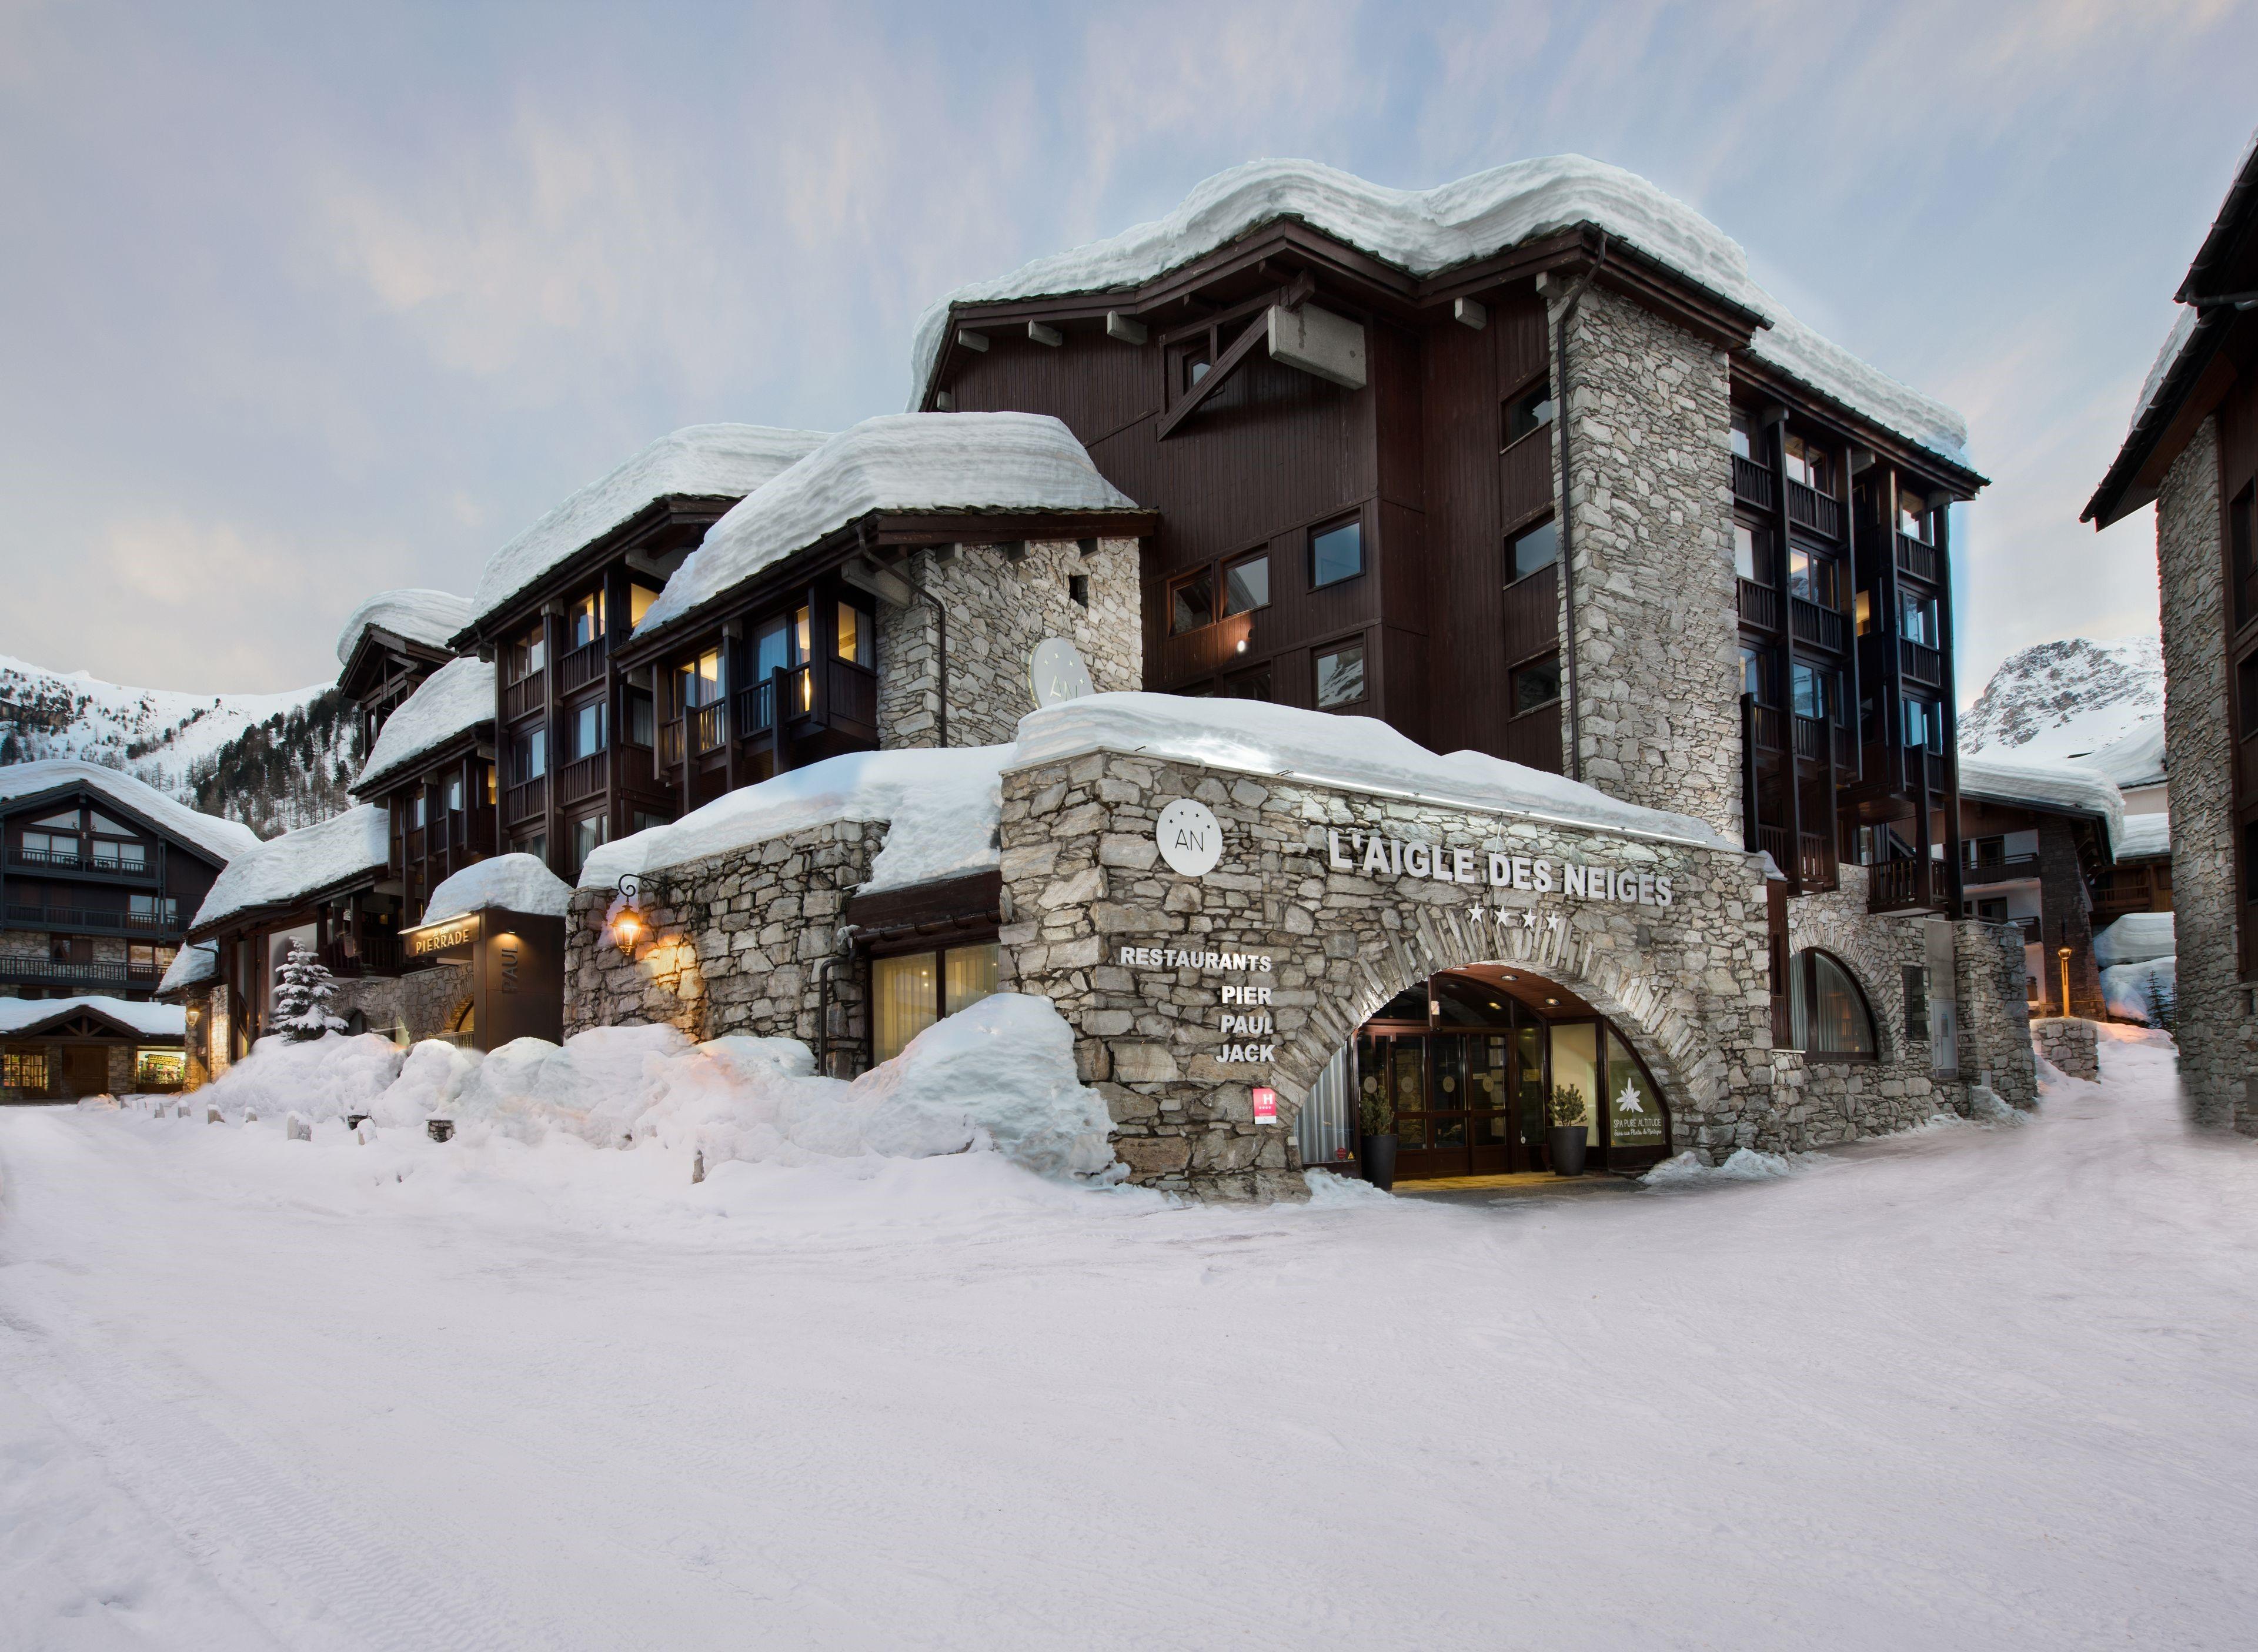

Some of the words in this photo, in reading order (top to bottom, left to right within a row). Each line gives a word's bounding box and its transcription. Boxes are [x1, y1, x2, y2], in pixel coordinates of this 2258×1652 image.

[1175, 828, 1204, 852] AN
[1328, 830, 1475, 884] L'AIGLE
[1489, 852, 1552, 893] DES
[1564, 862, 1673, 907] NEIGES
[416, 928, 470, 954] PIERRADE
[501, 942, 518, 992] PAUL
[1120, 947, 1272, 972] RESTAURANTS
[1221, 985, 1272, 1005] PIER
[1221, 1015, 1274, 1034] PAUL
[1215, 1044, 1276, 1062] JACK
[1263, 1094, 1273, 1105] H
[1613, 1119, 1624, 1128] SPA
[1624, 1119, 1637, 1128] PURE
[1638, 1118, 1662, 1127] ALTITUDE
